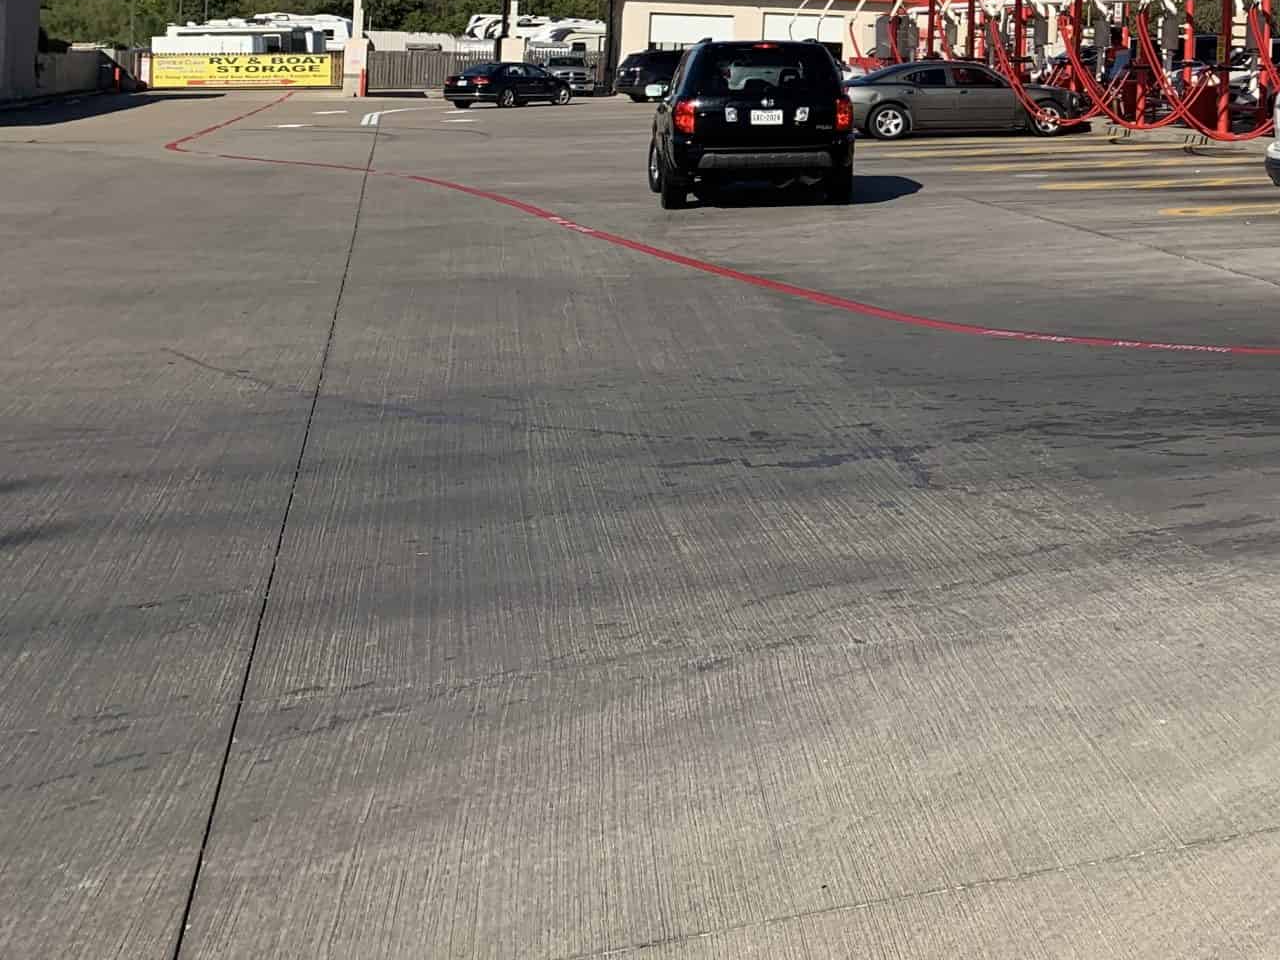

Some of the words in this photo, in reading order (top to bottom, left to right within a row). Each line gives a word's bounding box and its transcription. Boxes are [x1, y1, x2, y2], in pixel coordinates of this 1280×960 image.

[208, 57, 239, 65] RV
[247, 57, 262, 65] &
[271, 56, 329, 64] BOAT
[216, 65, 321, 73] STORAGE
